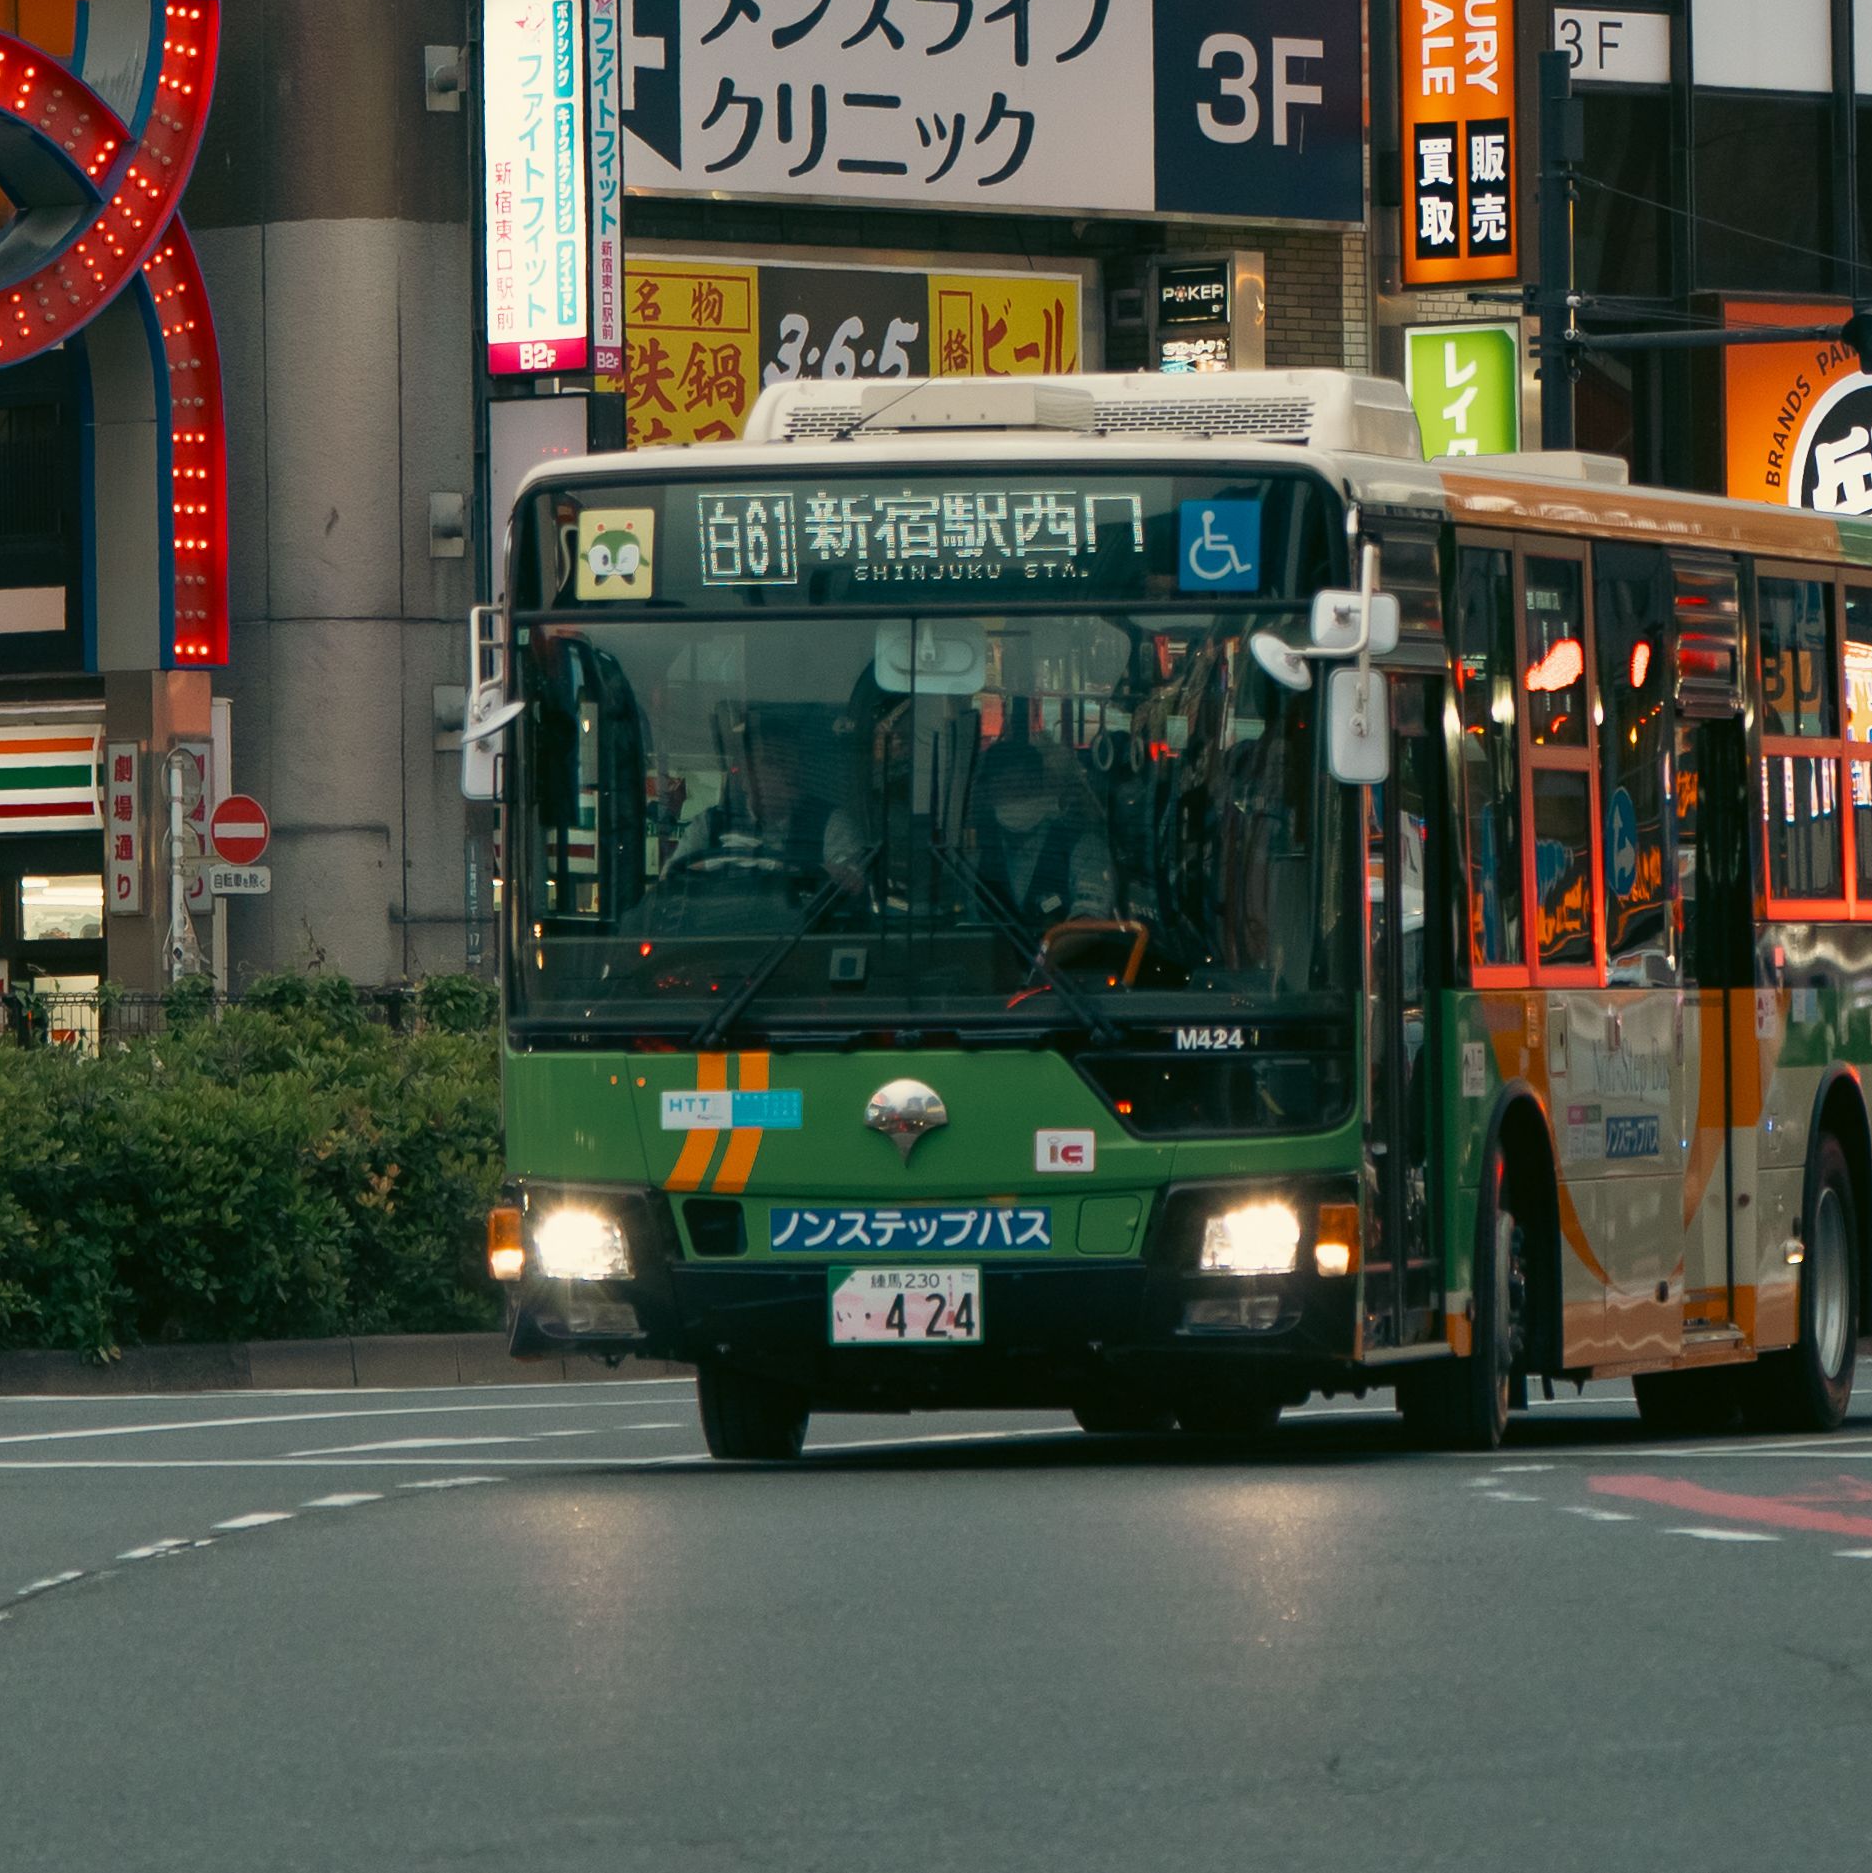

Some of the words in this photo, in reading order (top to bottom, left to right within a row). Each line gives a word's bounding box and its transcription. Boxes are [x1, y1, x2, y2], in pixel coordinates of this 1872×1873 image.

[555, 1, 570, 89] ボクシング
[1195, 31, 1326, 148] 3F
[557, 107, 575, 235] キックボクシング
[592, 17, 617, 237] ファイトフィット
[699, 75, 1036, 189] クリニック
[517, 53, 548, 330] ファイトフィット
[1419, 138, 1455, 246] 買取
[1471, 134, 1506, 244] 販売
[494, 161, 515, 332] 新宿東口駅前
[601, 240, 614, 342] 新宿東口駅前
[1162, 283, 1225, 303] POKER
[519, 341, 557, 370] B2F
[630, 278, 725, 328] 名物
[596, 350, 619, 370] B2F
[1765, 373, 1812, 489] BRANDS
[853, 564, 1003, 581] SHINJUKU
[114, 754, 134, 900] 劇場通り
[213, 870, 266, 891] 自転車を除く
[1176, 1027, 1244, 1051] M424
[771, 1211, 1052, 1248] ノンステップバス
